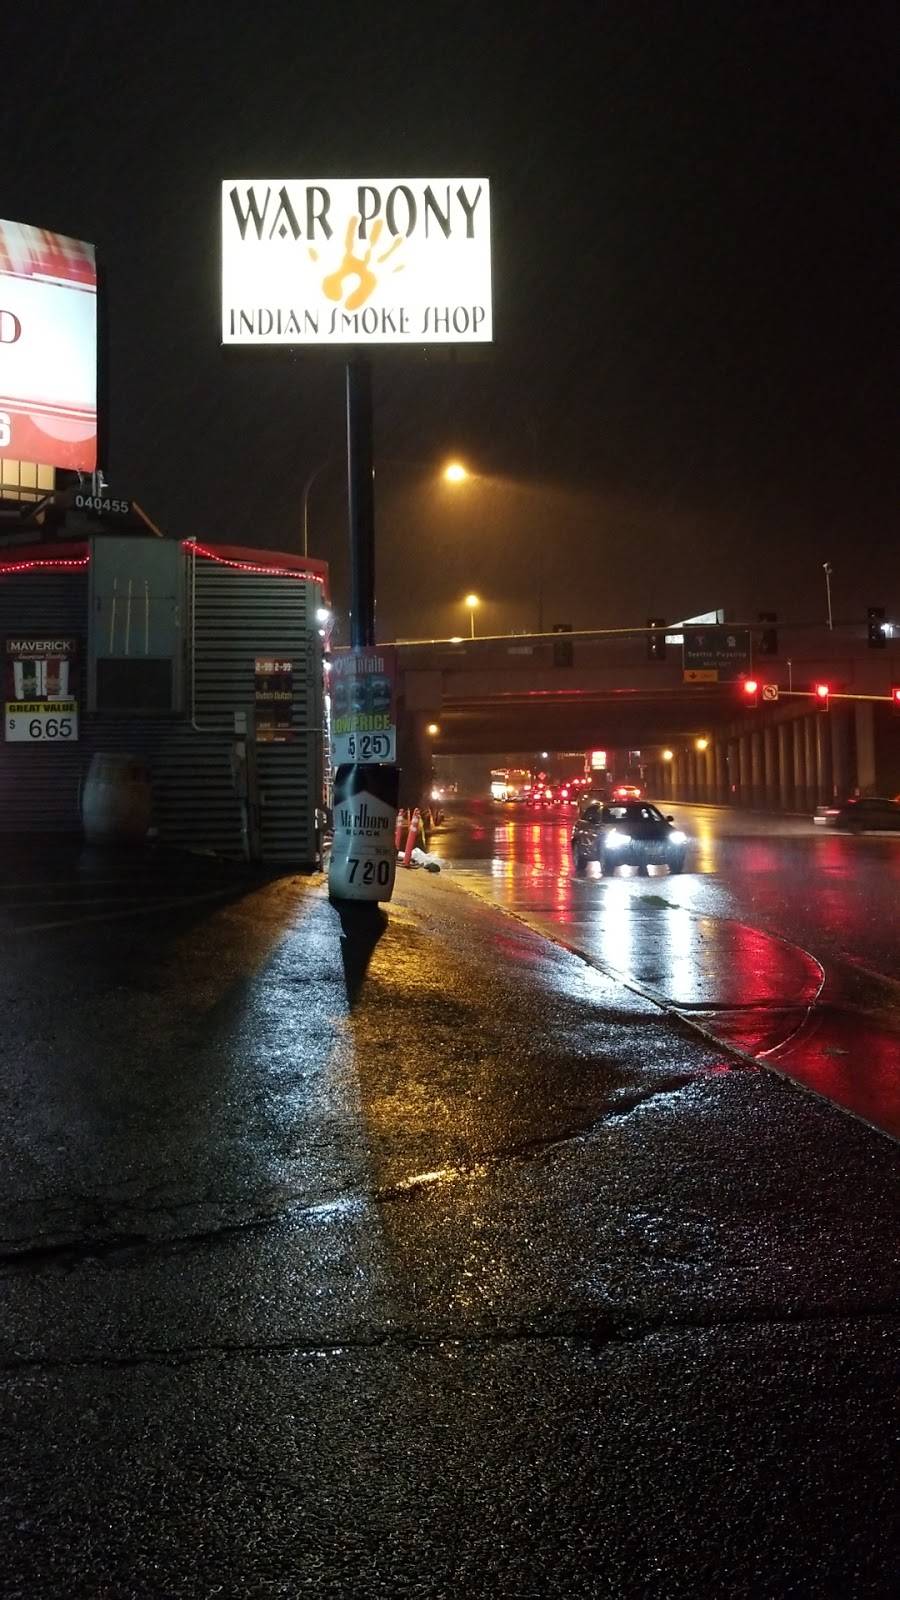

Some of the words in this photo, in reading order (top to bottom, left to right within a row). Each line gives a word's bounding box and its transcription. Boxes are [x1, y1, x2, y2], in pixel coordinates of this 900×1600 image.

[229, 185, 333, 240] WAR
[357, 184, 482, 240] PONY
[230, 307, 319, 336] INDIAN
[328, 306, 410, 335] SMOKE
[421, 306, 485, 334] SHOP
[75, 495, 129, 513] 040455
[10, 641, 72, 650] MAVERICK
[9, 704, 40, 712] GREAT
[43, 704, 74, 712] VALUE
[353, 714, 391, 731] PRICE
[340, 803, 388, 828] Marlboro
[345, 829, 381, 837] BLACK
